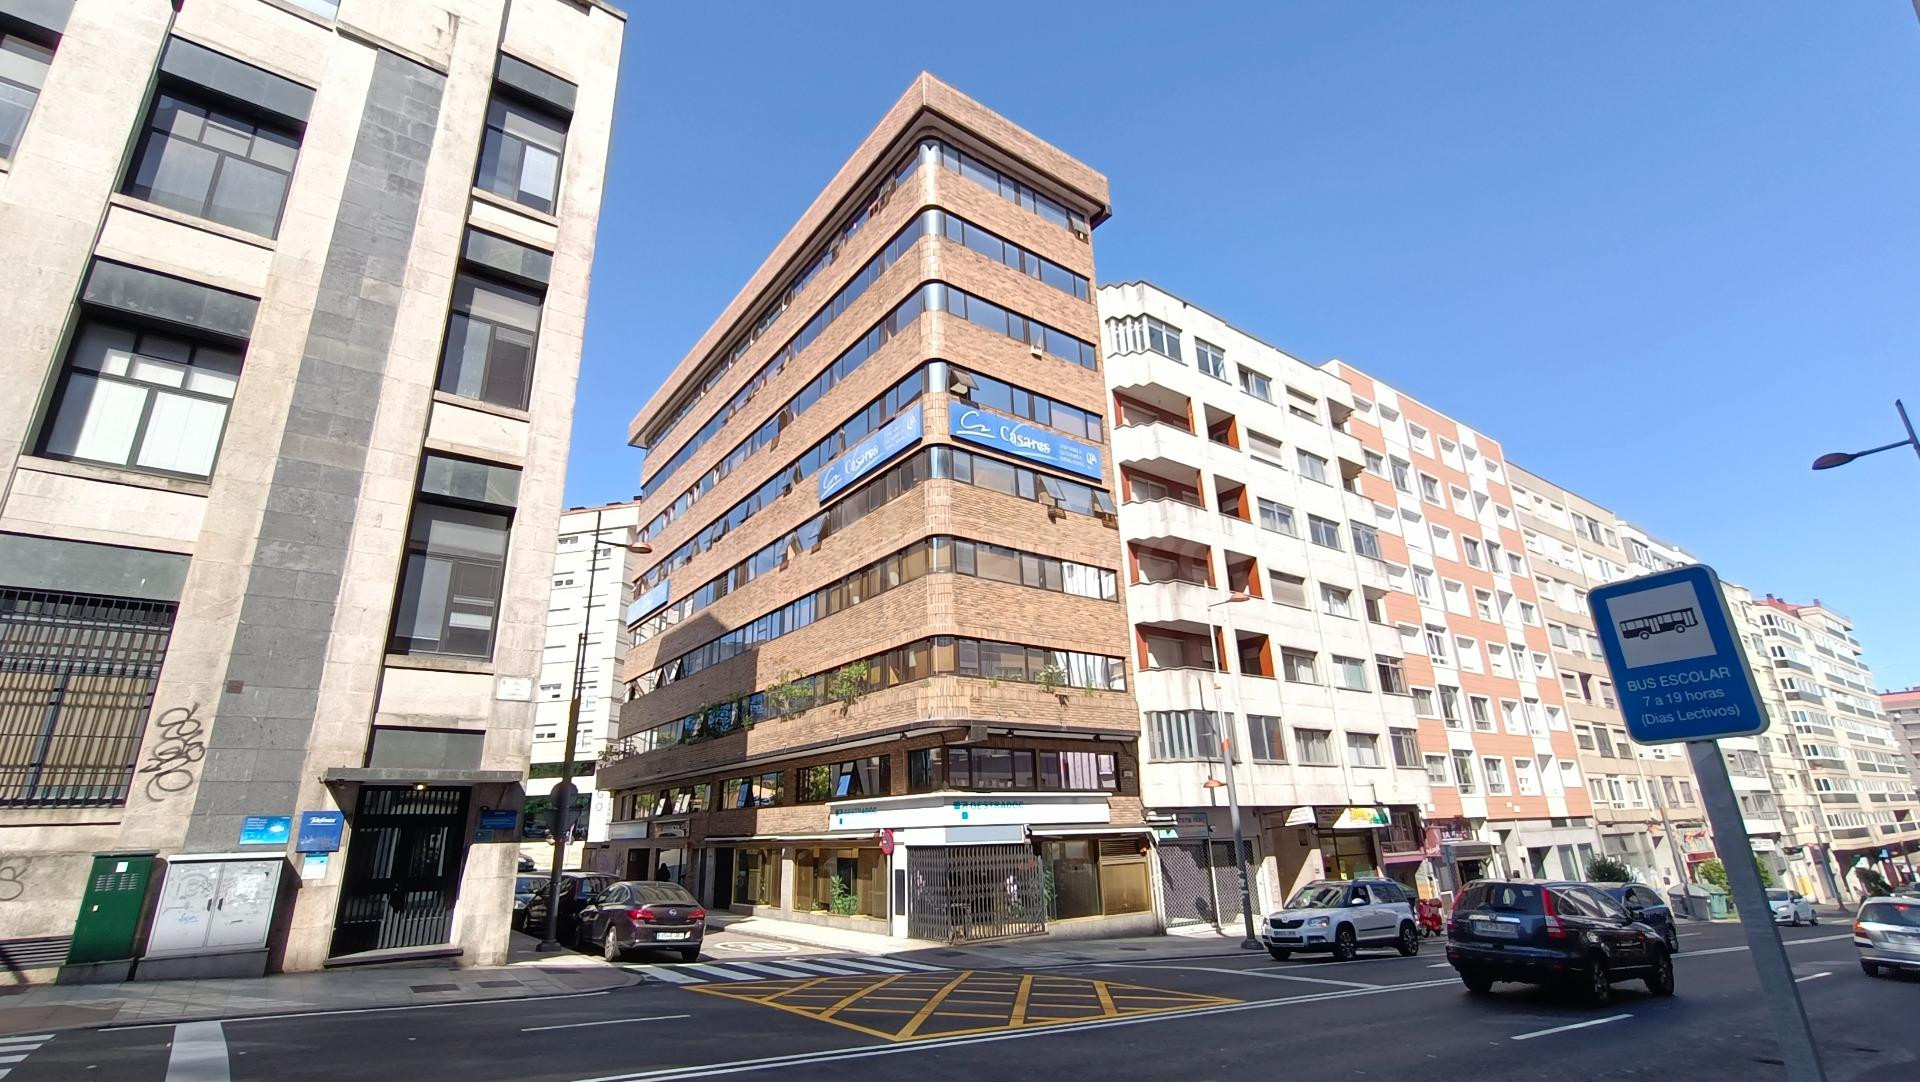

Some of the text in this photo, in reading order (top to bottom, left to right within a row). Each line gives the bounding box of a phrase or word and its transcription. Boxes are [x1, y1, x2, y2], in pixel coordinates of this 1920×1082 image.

[1626, 667, 1731, 692] BUS ESCOLAR
[1642, 687, 1725, 707] 7 a 19 horas
[1676, 704, 1740, 722] Lectivos)
